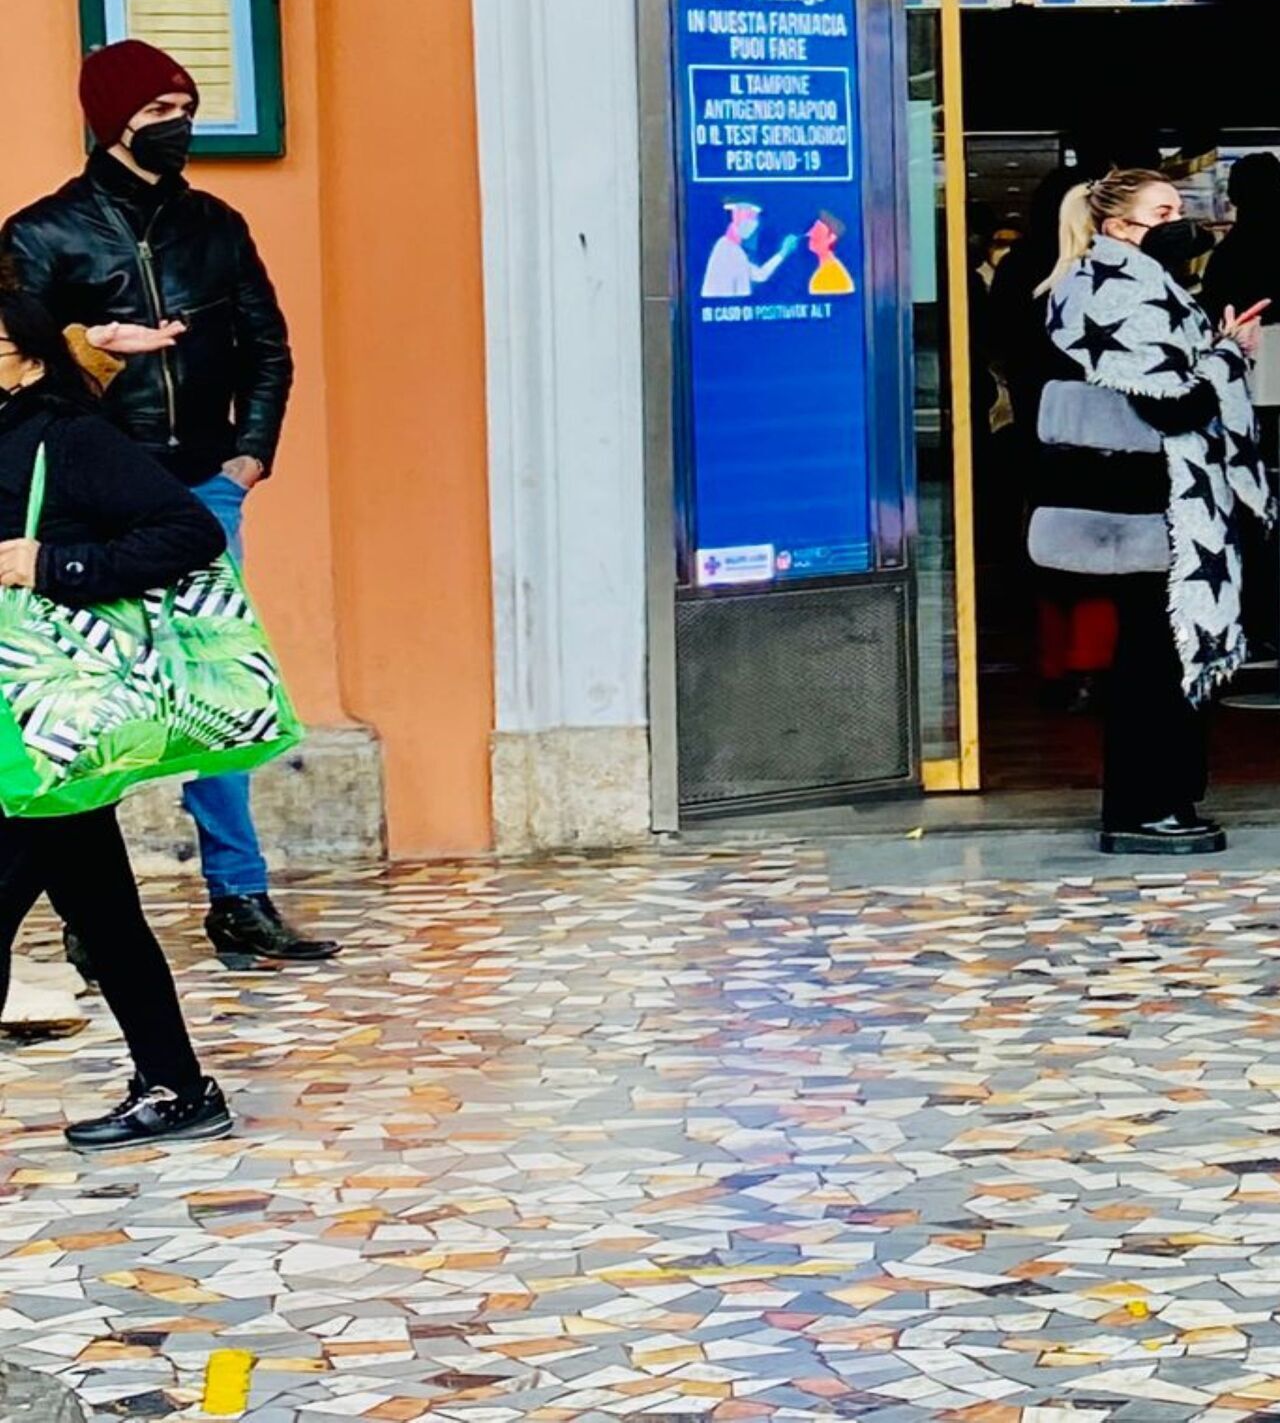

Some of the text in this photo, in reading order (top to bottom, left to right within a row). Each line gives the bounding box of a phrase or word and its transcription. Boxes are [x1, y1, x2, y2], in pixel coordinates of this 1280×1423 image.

[688, 9, 848, 36] IN QUESTA FARMACIA
[730, 36, 807, 60] PUOI FARE
[730, 74, 810, 95] IL TAMPONE
[704, 99, 837, 120] ANTIGENICO RAPIDO
[696, 125, 846, 145] O IL TEST SIEROLOGICO
[726, 150, 754, 170] PER
